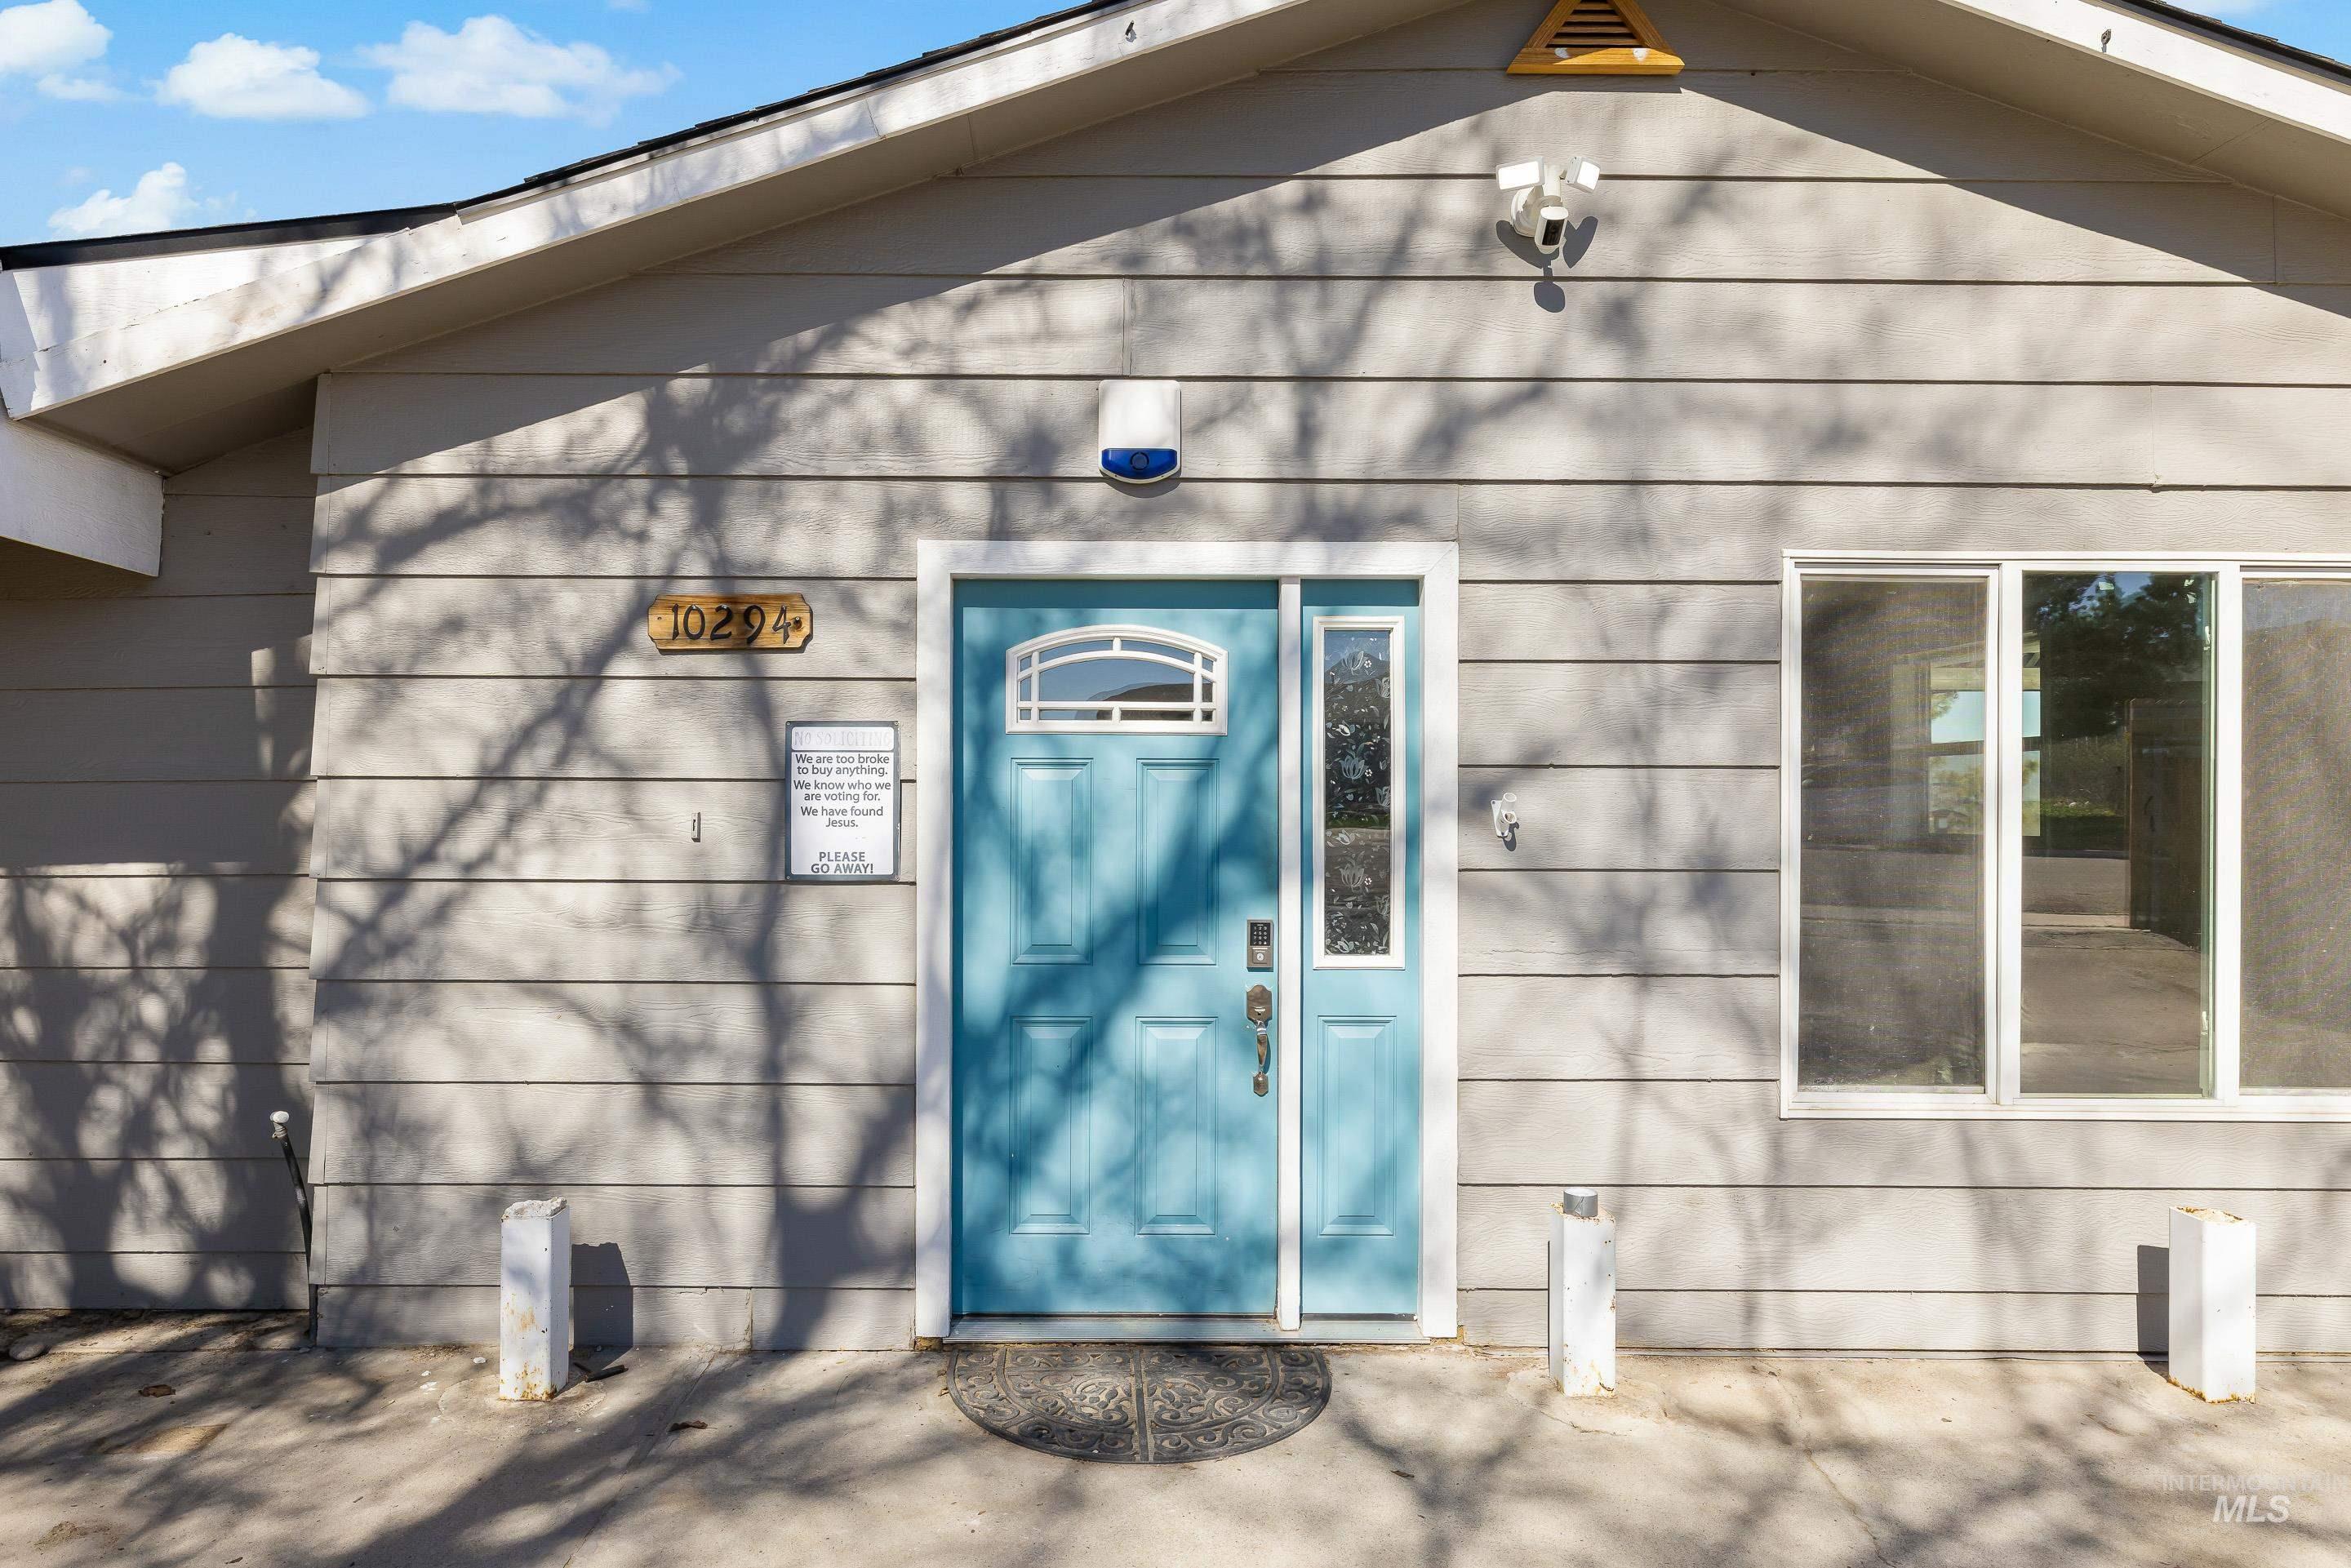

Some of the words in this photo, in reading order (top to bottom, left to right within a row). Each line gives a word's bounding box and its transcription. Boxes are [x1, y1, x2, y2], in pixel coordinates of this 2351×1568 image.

[671, 603, 792, 645] 10294
[794, 731, 811, 747] NO
[796, 754, 813, 763] We
[836, 755, 855, 763] too
[858, 753, 889, 763] broke
[798, 766, 809, 775] to
[812, 765, 833, 776] buy
[836, 765, 888, 776] anything.
[793, 780, 811, 790] We
[814, 780, 845, 790] know
[848, 780, 872, 790] who
[804, 793, 821, 801] are
[824, 791, 860, 803] voting
[863, 791, 880, 801] for.
[801, 806, 818, 816] We
[821, 806, 847, 816] have
[851, 806, 883, 816] found
[825, 818, 858, 828] Jesus.
[820, 852, 865, 862] PLEASE
[811, 864, 829, 873] GO
[834, 864, 873, 873] AWAY!
